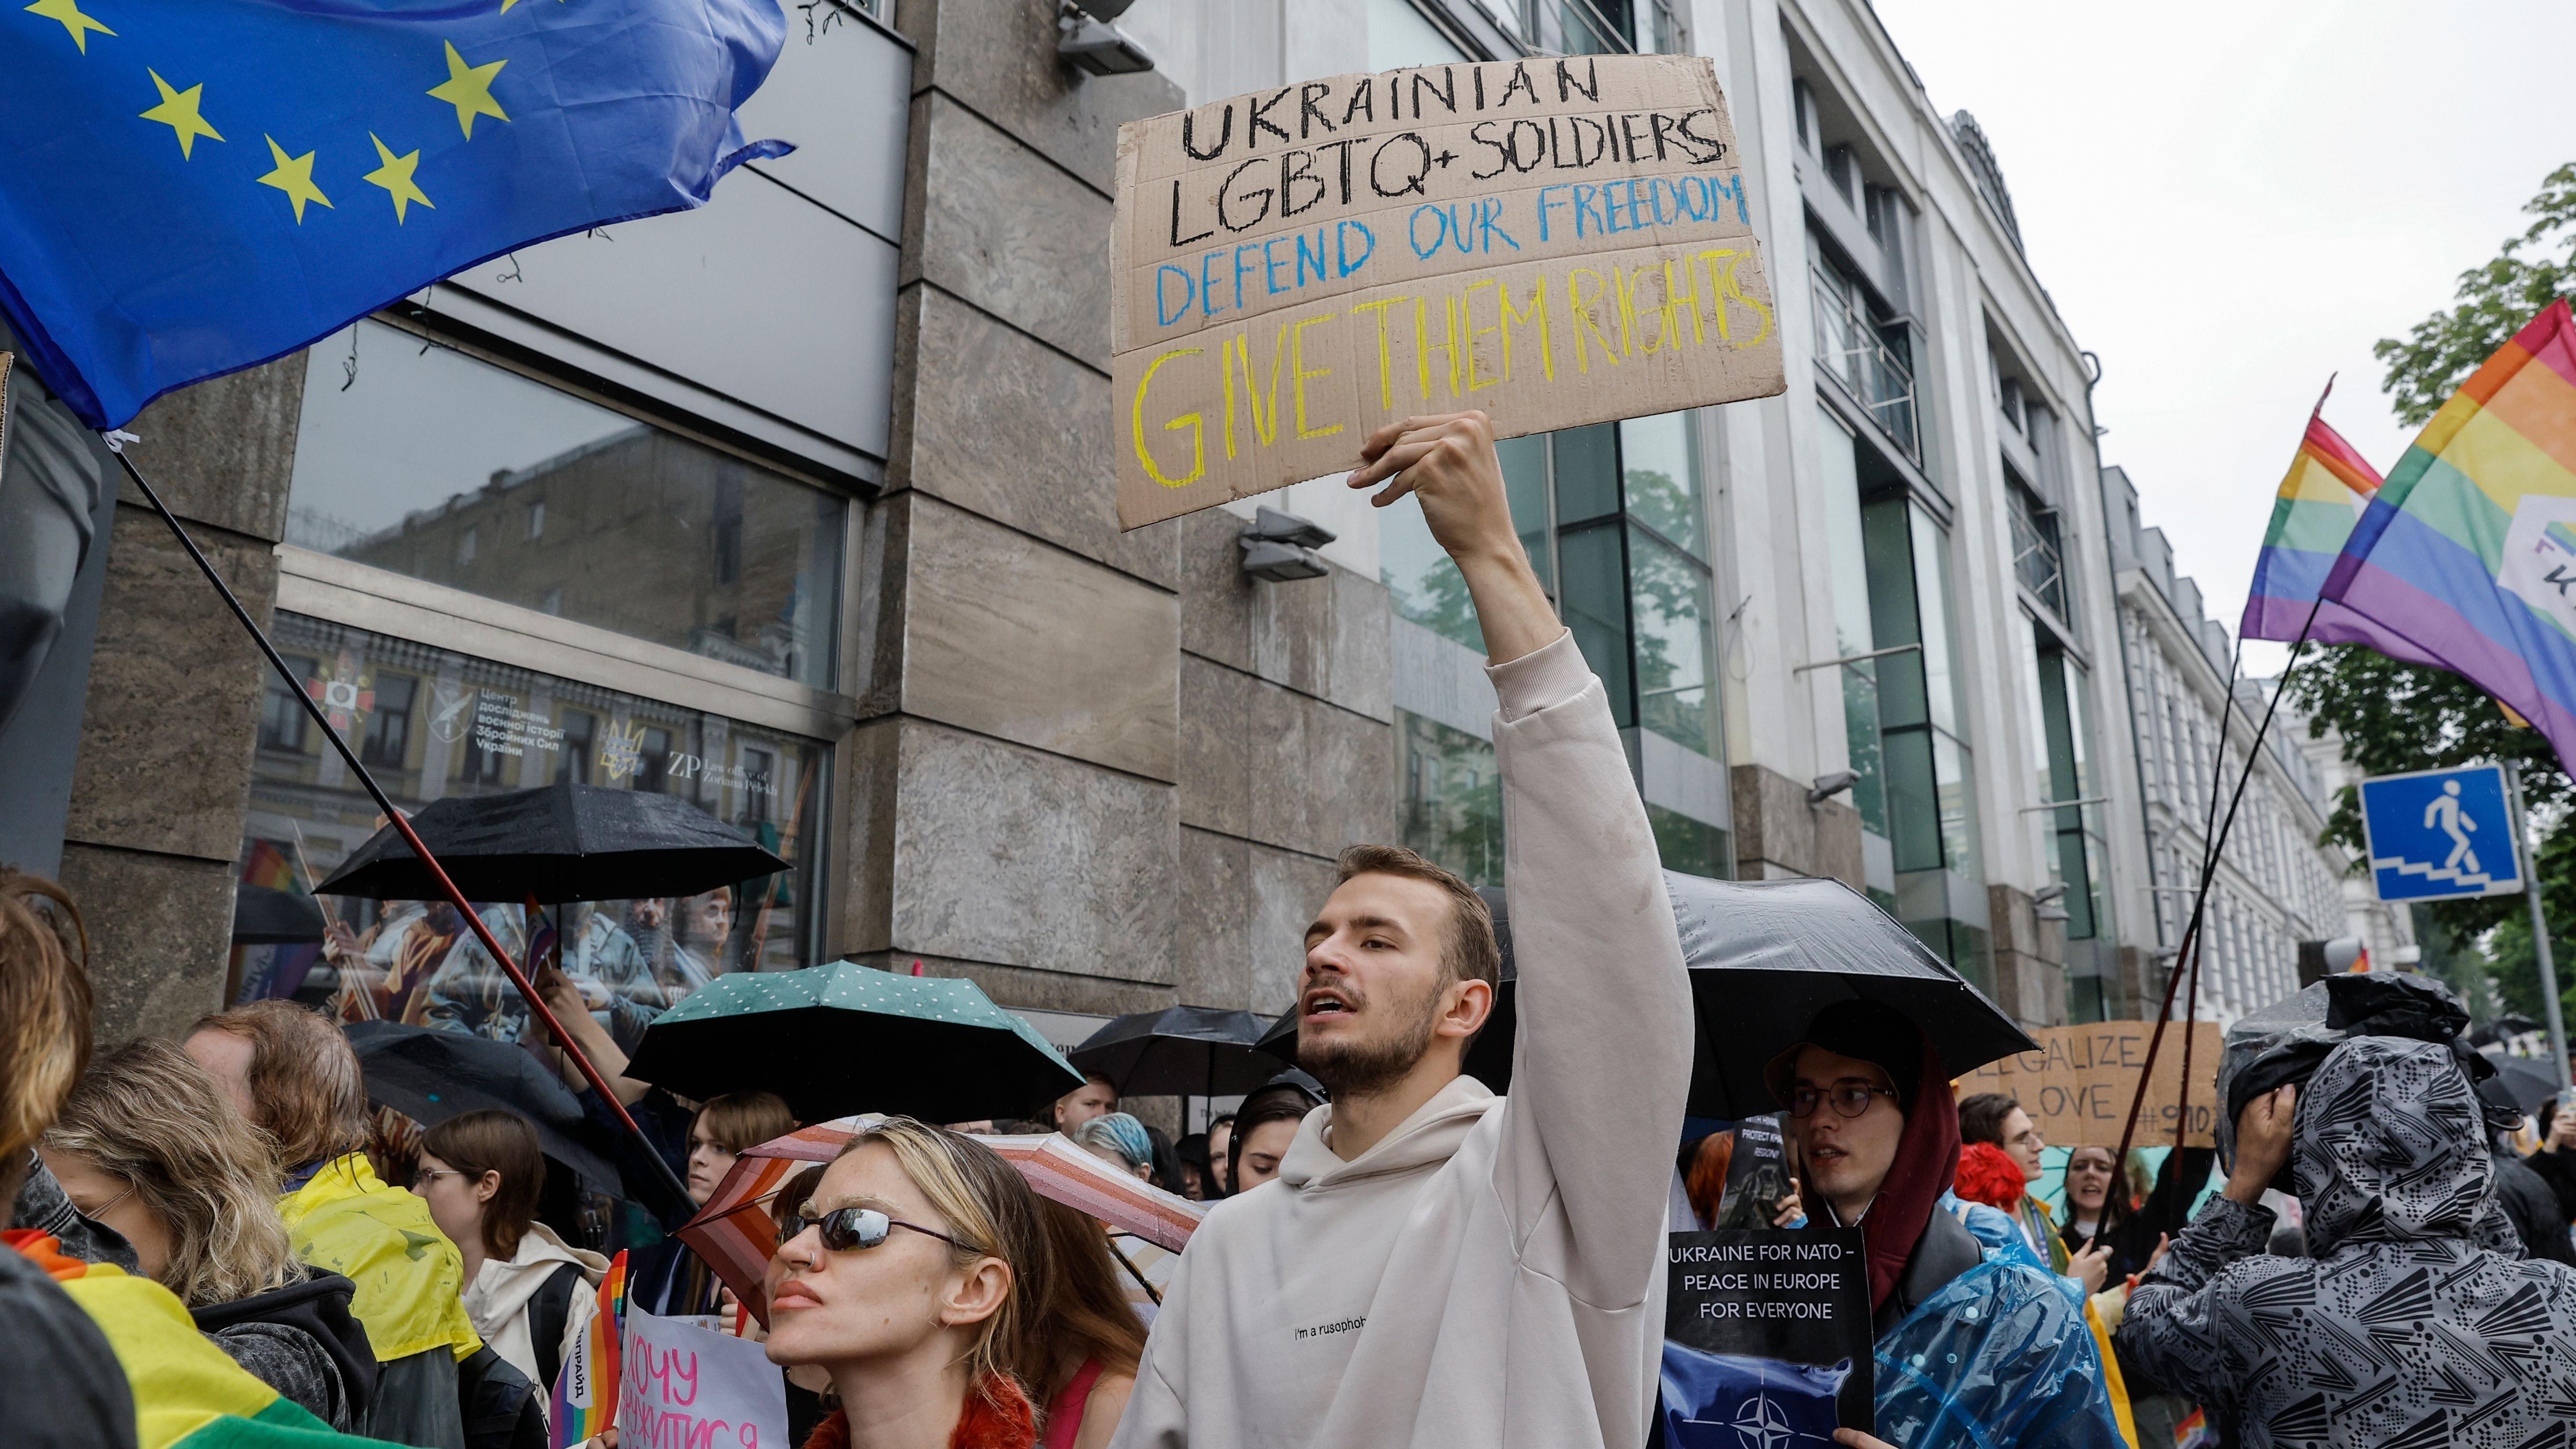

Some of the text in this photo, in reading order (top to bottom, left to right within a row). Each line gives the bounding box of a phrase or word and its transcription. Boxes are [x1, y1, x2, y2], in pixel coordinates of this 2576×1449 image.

[1183, 58, 1599, 162] UKRAINIAN
[1170, 109, 1726, 246] LGBTQ+ SOLDIERS
[1157, 176, 1750, 326] DEFEND OUR FREEDOM
[1133, 249, 1772, 489] GIVE THEM RIGHTS
[481, 688, 518, 707] Центр
[476, 738, 523, 757] України
[477, 725, 559, 751] Збройних Сил
[667, 751, 701, 779] ZP
[2136, 1105, 2216, 1137] #910
[1742, 1129, 1769, 1141] PROTECT
[1669, 1245, 1754, 1263] UKRAINE
[1759, 1245, 1791, 1260] FOR
[1796, 1244, 1841, 1260] NATO
[1684, 1273, 1841, 1291] PEACE IN EUROPE
[1700, 1302, 1832, 1319] FOR EVERYONE
[1311, 1327, 1316, 1337] a
